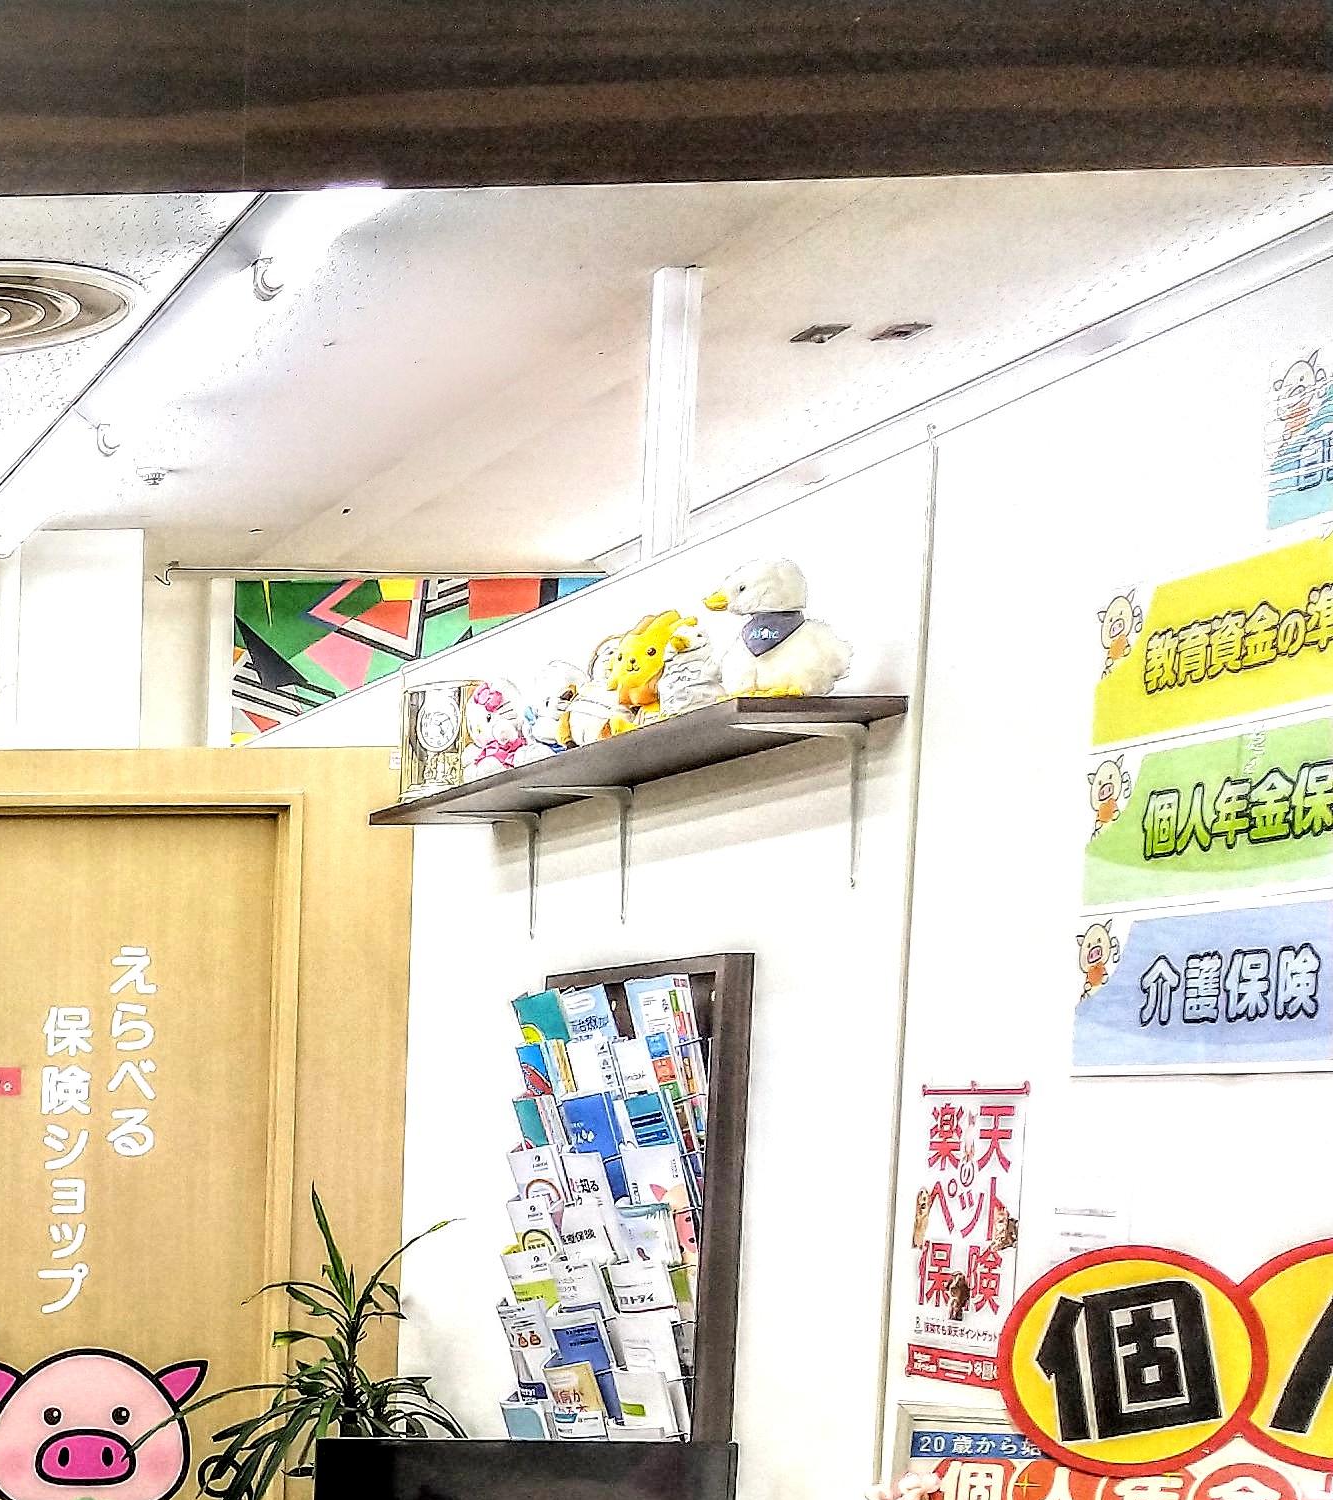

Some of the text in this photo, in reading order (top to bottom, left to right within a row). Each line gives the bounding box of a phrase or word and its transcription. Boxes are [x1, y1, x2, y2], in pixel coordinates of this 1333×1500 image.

[1141, 760, 1333, 862] 個人年金保
[1139, 944, 1320, 1027] 介護保険
[106, 944, 159, 1158] えらべる
[37, 1006, 95, 1316] 保険ショップ
[926, 1102, 1017, 1173] 楽天
[931, 1175, 1007, 1242] ペット
[917, 1239, 1004, 1316] 保険
